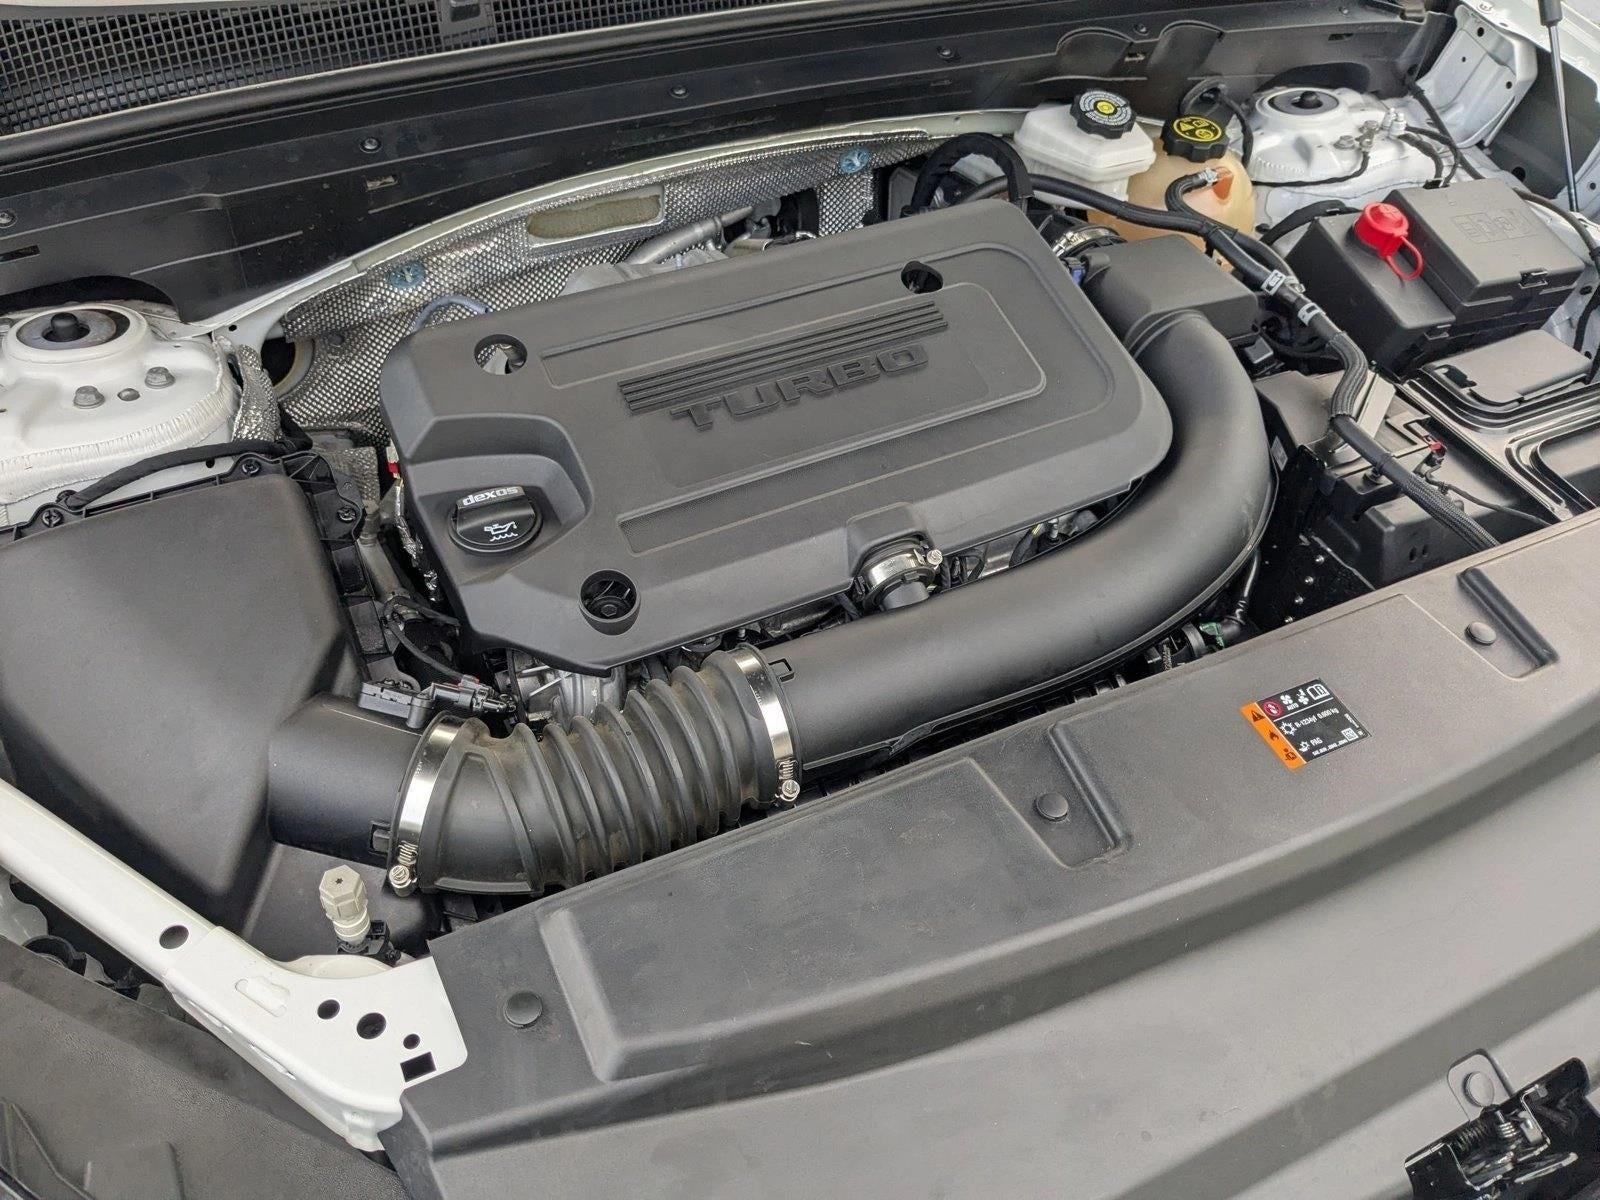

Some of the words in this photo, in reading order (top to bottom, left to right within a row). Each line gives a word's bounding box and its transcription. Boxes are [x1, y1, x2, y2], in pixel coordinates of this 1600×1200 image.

[669, 344, 929, 431] TURBO
[462, 486, 518, 506] dexos
[1294, 715, 1318, 729] R-1234yf
[1310, 737, 1323, 746] PAG
